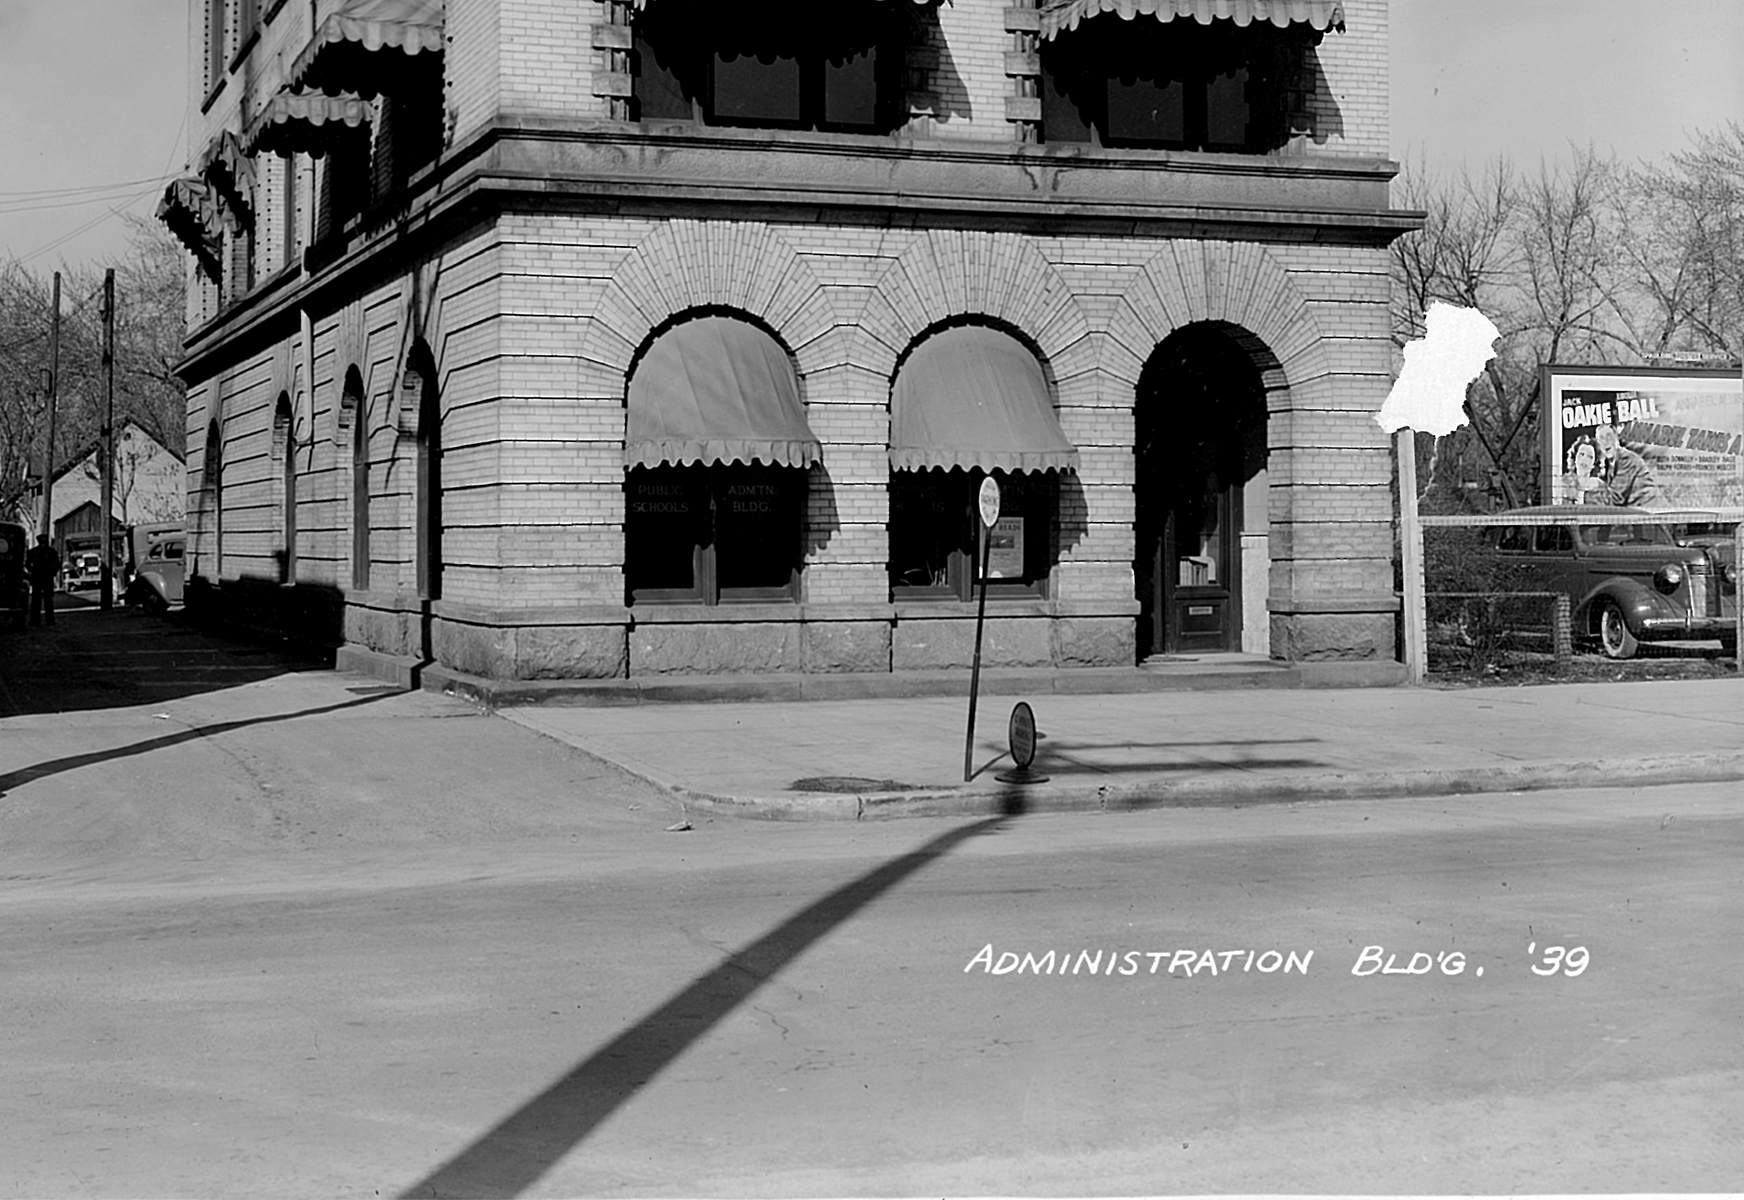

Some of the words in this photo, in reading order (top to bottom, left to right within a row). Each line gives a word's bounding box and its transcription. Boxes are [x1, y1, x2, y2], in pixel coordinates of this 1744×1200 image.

[1562, 397, 1582, 406] JACK
[1562, 402, 1612, 429] OAKIE
[1616, 398, 1660, 423] BALL
[1620, 421, 1687, 448] ANNABEL
[1687, 429, 1733, 453] TAKES
[1728, 435, 1742, 455] A
[638, 485, 683, 496] PUBLIC
[632, 502, 689, 513] SCHOOLS
